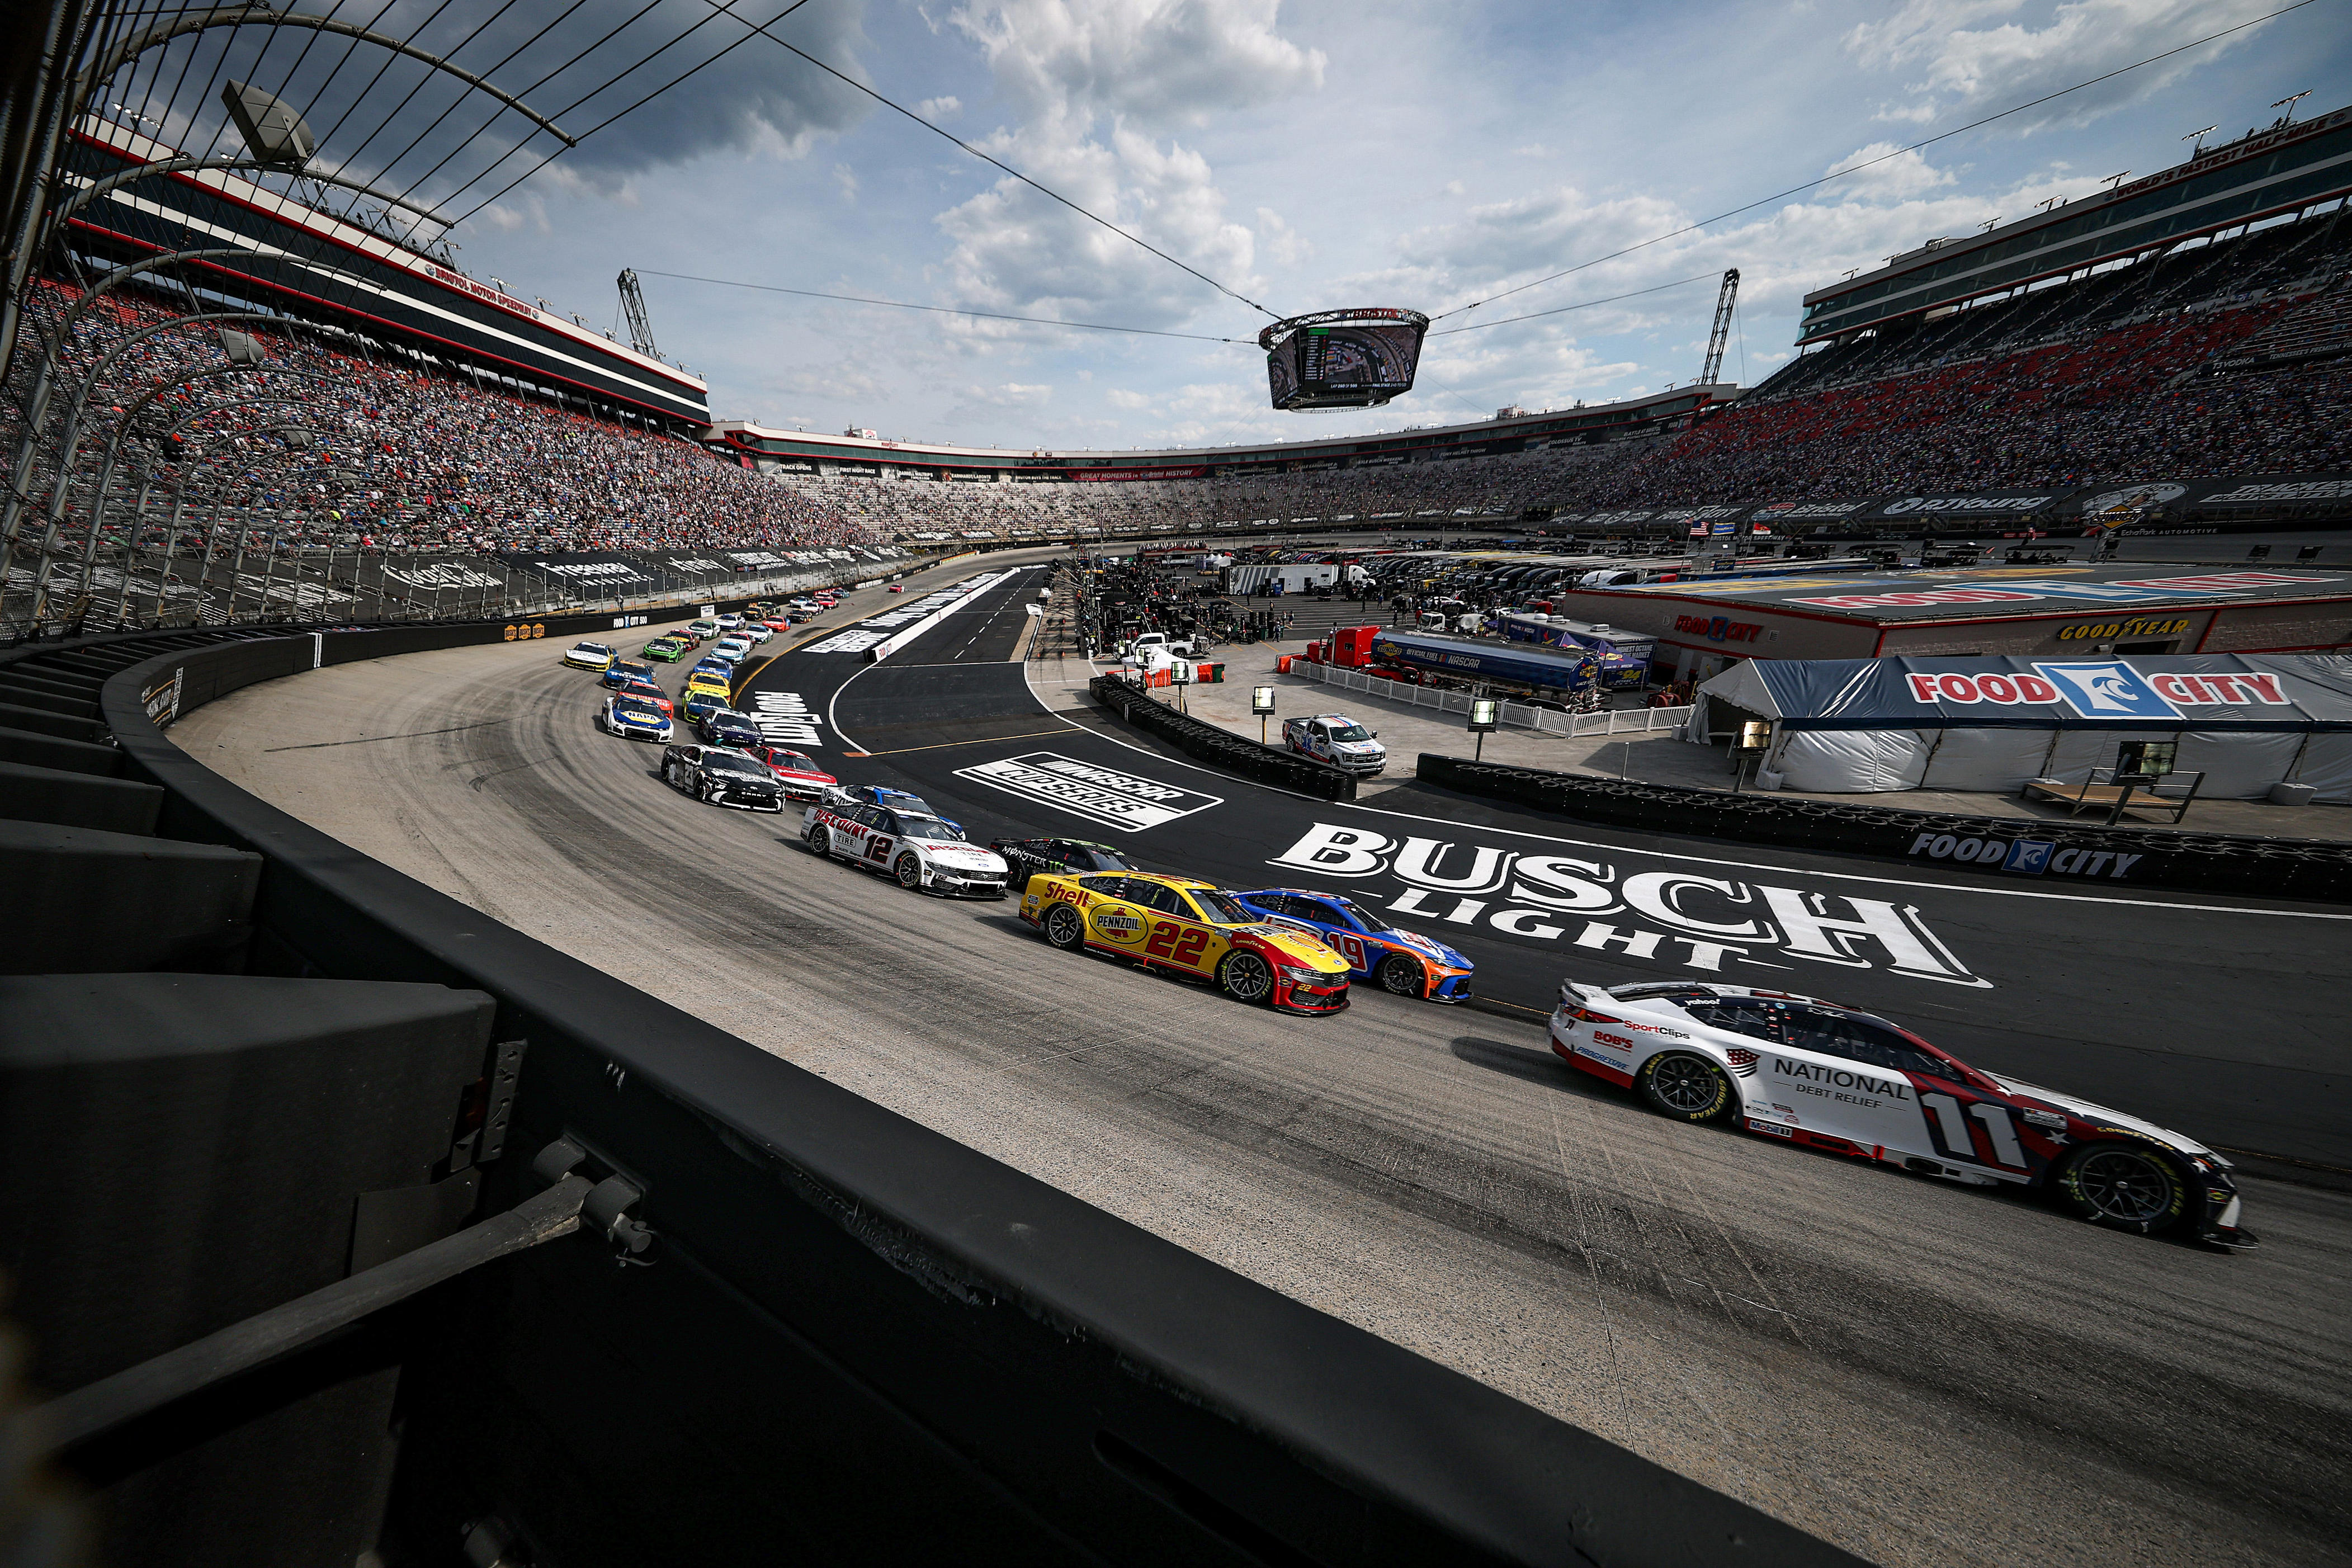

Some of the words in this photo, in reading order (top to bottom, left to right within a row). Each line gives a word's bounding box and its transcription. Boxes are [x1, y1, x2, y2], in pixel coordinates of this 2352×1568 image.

[2116, 170, 2174, 198] WORLD'S
[2180, 148, 2240, 176] FASTEST
[2242, 118, 2327, 155] HALF-MILE
[436, 267, 469, 290] BRISTOL
[471, 283, 497, 303] MOTOR
[498, 294, 532, 317] SPEEDWAY
[1353, 308, 1399, 319] BRISTOL
[2223, 357, 2255, 368] VODKA
[534, 561, 638, 577] Freeway
[613, 617, 624, 628] FOOD
[630, 616, 639, 626] CITY
[1674, 615, 1709, 636] FOOD
[1725, 622, 1764, 642] CITY
[2059, 617, 2189, 641] GOODYEAR
[1377, 646, 1402, 655] SUNOCO
[1406, 649, 1425, 658] OFFICIAL
[1427, 651, 1438, 660] FUEL
[1448, 655, 1481, 669] NASCAR
[1905, 672, 2062, 705] FOOD
[2147, 672, 2292, 705] CITY
[629, 712, 657, 721] NAPA
[778, 768, 832, 780] Motorcraft
[1069, 763, 1184, 802] NASCAR
[997, 769, 1055, 791] CUP
[1042, 780, 1146, 814] SERIES
[814, 809, 870, 840] DISCOUNT
[838, 835, 854, 847] TIRE
[863, 834, 894, 865] 12
[1907, 833, 2007, 865] FOOD
[2050, 848, 2143, 877] CITY
[1045, 881, 1090, 908] Shell
[1265, 821, 1995, 989] BUSCH
[1097, 915, 1141, 931] PENNZOIL
[1385, 886, 1751, 972] LIGHT
[1145, 921, 1210, 966] 22
[1236, 939, 1266, 950] GOODYEAR
[1327, 932, 1368, 973] 19
[1297, 983, 1312, 992] 22
[1594, 1031, 1633, 1049] BOB'S
[1576, 1046, 1629, 1070] PROGRESSIVE
[1774, 1059, 1909, 1101] NATIONAL
[1690, 1079, 1727, 1119] GOODYEAR
[1796, 1084, 1832, 1098] DEBT
[1834, 1091, 1882, 1109] RELIEF
[1751, 1121, 1779, 1135] Mobil
[1920, 1092, 2028, 1169] 11
[2096, 1126, 2174, 1151] GOODYEAR
